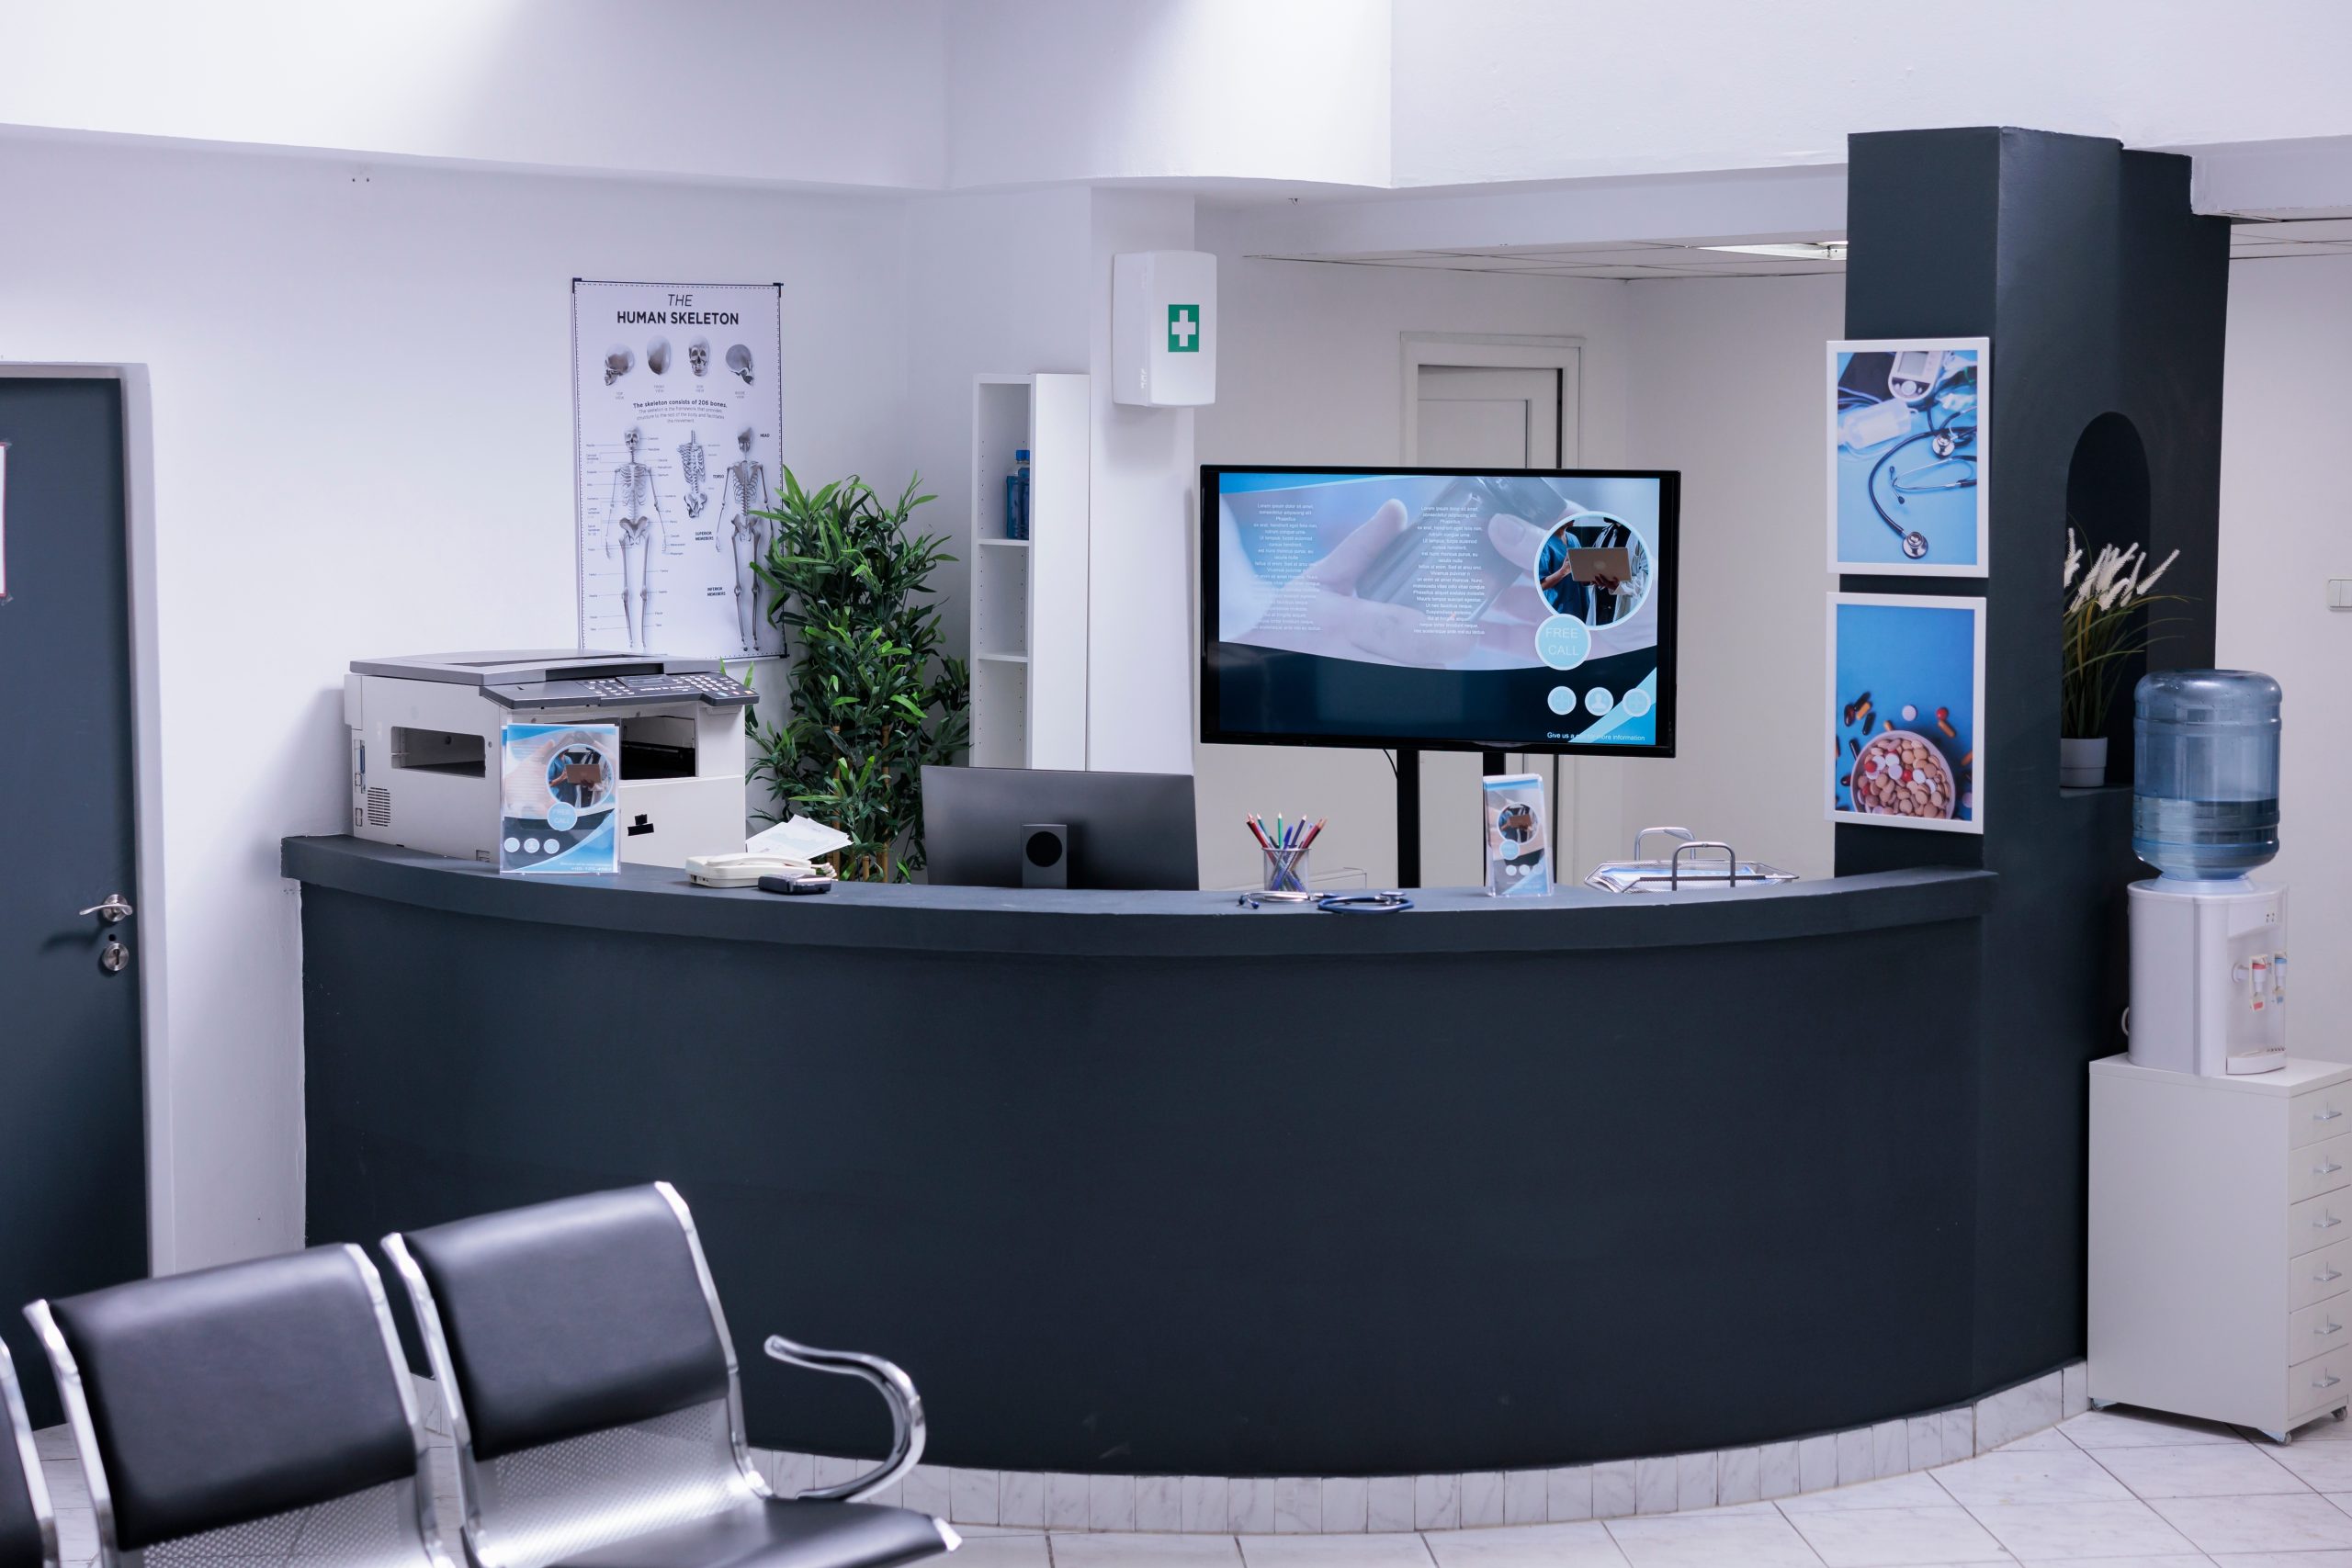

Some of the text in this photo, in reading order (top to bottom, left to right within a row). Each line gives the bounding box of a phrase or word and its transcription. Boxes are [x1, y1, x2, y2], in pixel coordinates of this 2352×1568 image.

[668, 294, 693, 307] THE
[617, 311, 739, 325] HUMAN SKELETON
[1546, 628, 1578, 638] FREE
[1548, 646, 1578, 656] CALL
